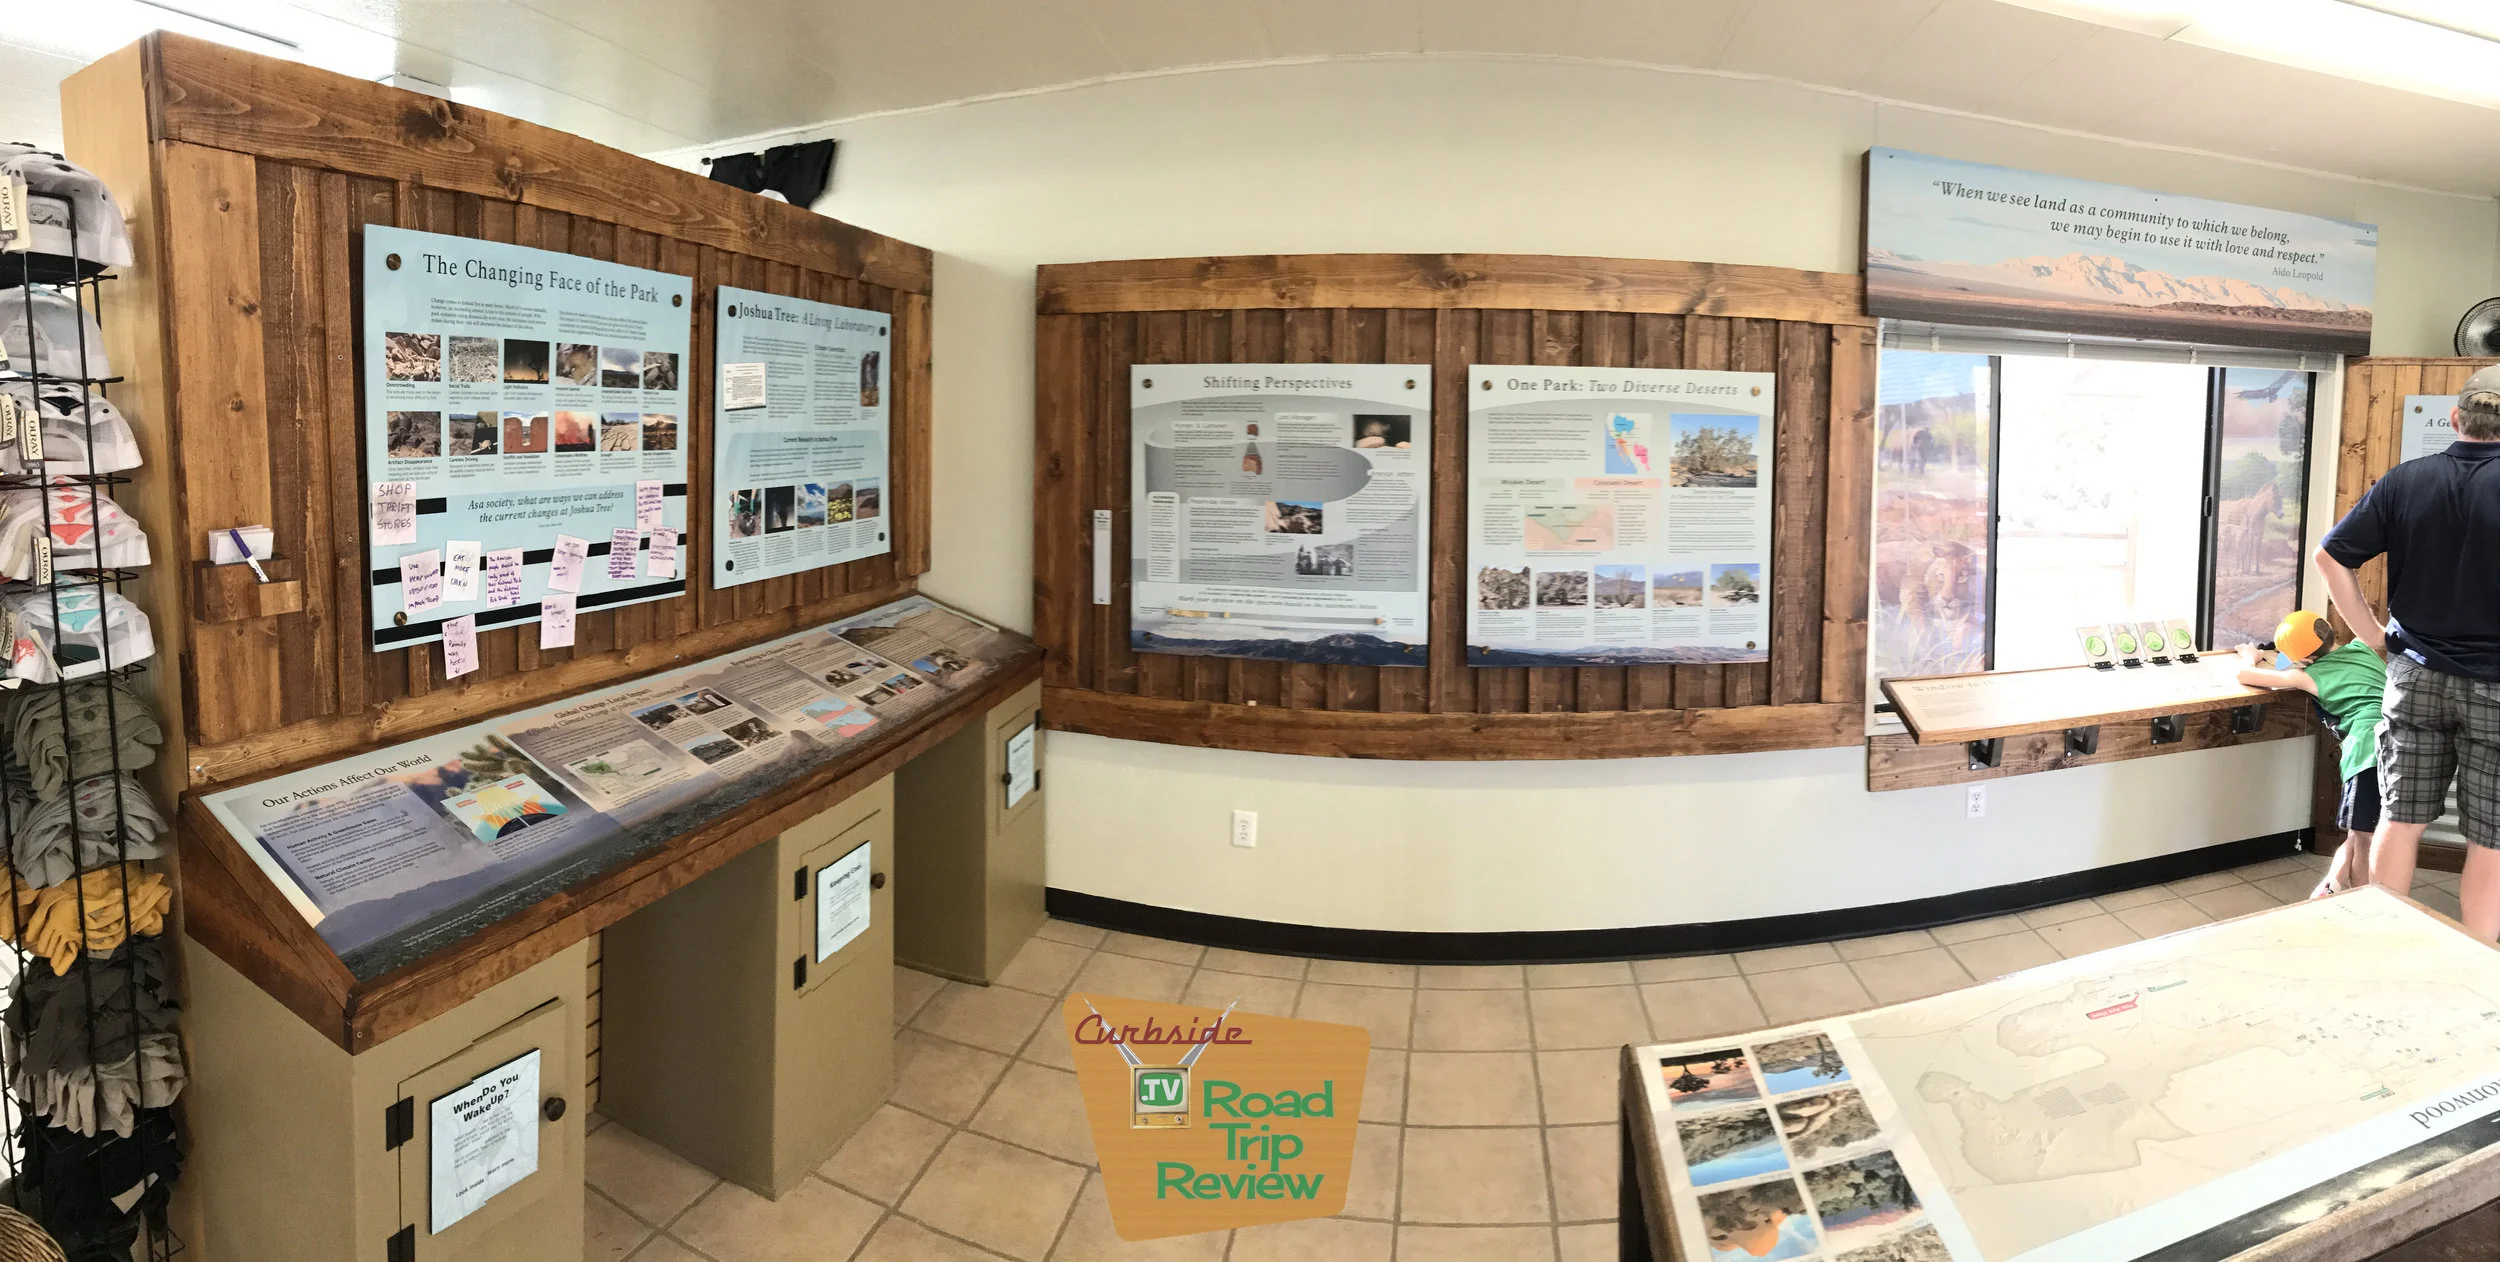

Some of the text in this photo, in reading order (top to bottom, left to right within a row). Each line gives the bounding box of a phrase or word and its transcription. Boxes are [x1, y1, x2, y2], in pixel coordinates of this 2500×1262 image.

[2, 187, 12, 226] OURAY
[1932, 180, 2290, 246] “When we see land as a community to which we belong,
[2050, 220, 2324, 265] we may begin to use it with love and respect.”
[422, 254, 658, 303] The Changing Face of the Park
[2272, 267, 2324, 282] Aldo Leopold
[738, 302, 772, 320] Joshua
[775, 307, 799, 323] Tree:
[1203, 376, 1353, 392] Shifting Perspectives
[1507, 379, 1737, 396] One Park: Two Diverse Deserts
[2425, 418, 2451, 428] A Ge
[29, 420, 39, 456] OURAY
[378, 483, 412, 498] SHOP
[486, 498, 515, 509] society,
[518, 496, 538, 506] what
[553, 496, 571, 507] ways
[598, 490, 624, 500] address
[378, 502, 415, 514] THRIFT
[480, 504, 614, 523] the current changes at Joshua Tree?
[377, 518, 412, 531] STORES
[1912, 684, 1963, 692] Window
[554, 708, 578, 719] Global
[263, 754, 432, 808] Our Actions Affect Our World
[454, 1073, 519, 1115] When Do You
[463, 1090, 510, 1123] Wake Up?
